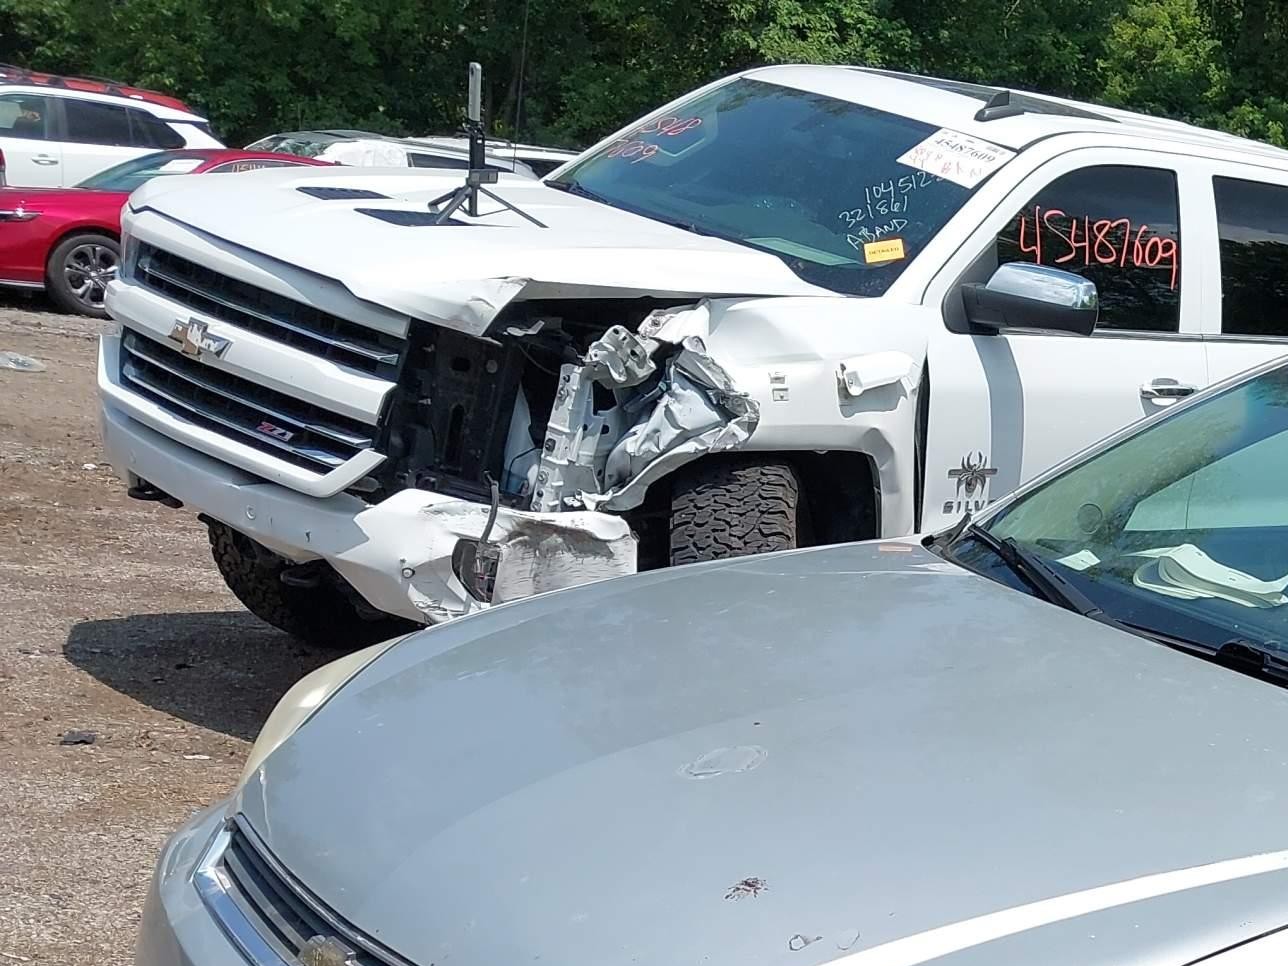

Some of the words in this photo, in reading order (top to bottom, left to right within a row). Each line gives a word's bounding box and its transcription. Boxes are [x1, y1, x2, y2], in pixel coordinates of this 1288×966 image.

[846, 219, 908, 250] ABAND
[1020, 205, 1177, 290] 45487609
[942, 500, 994, 514] SILV
